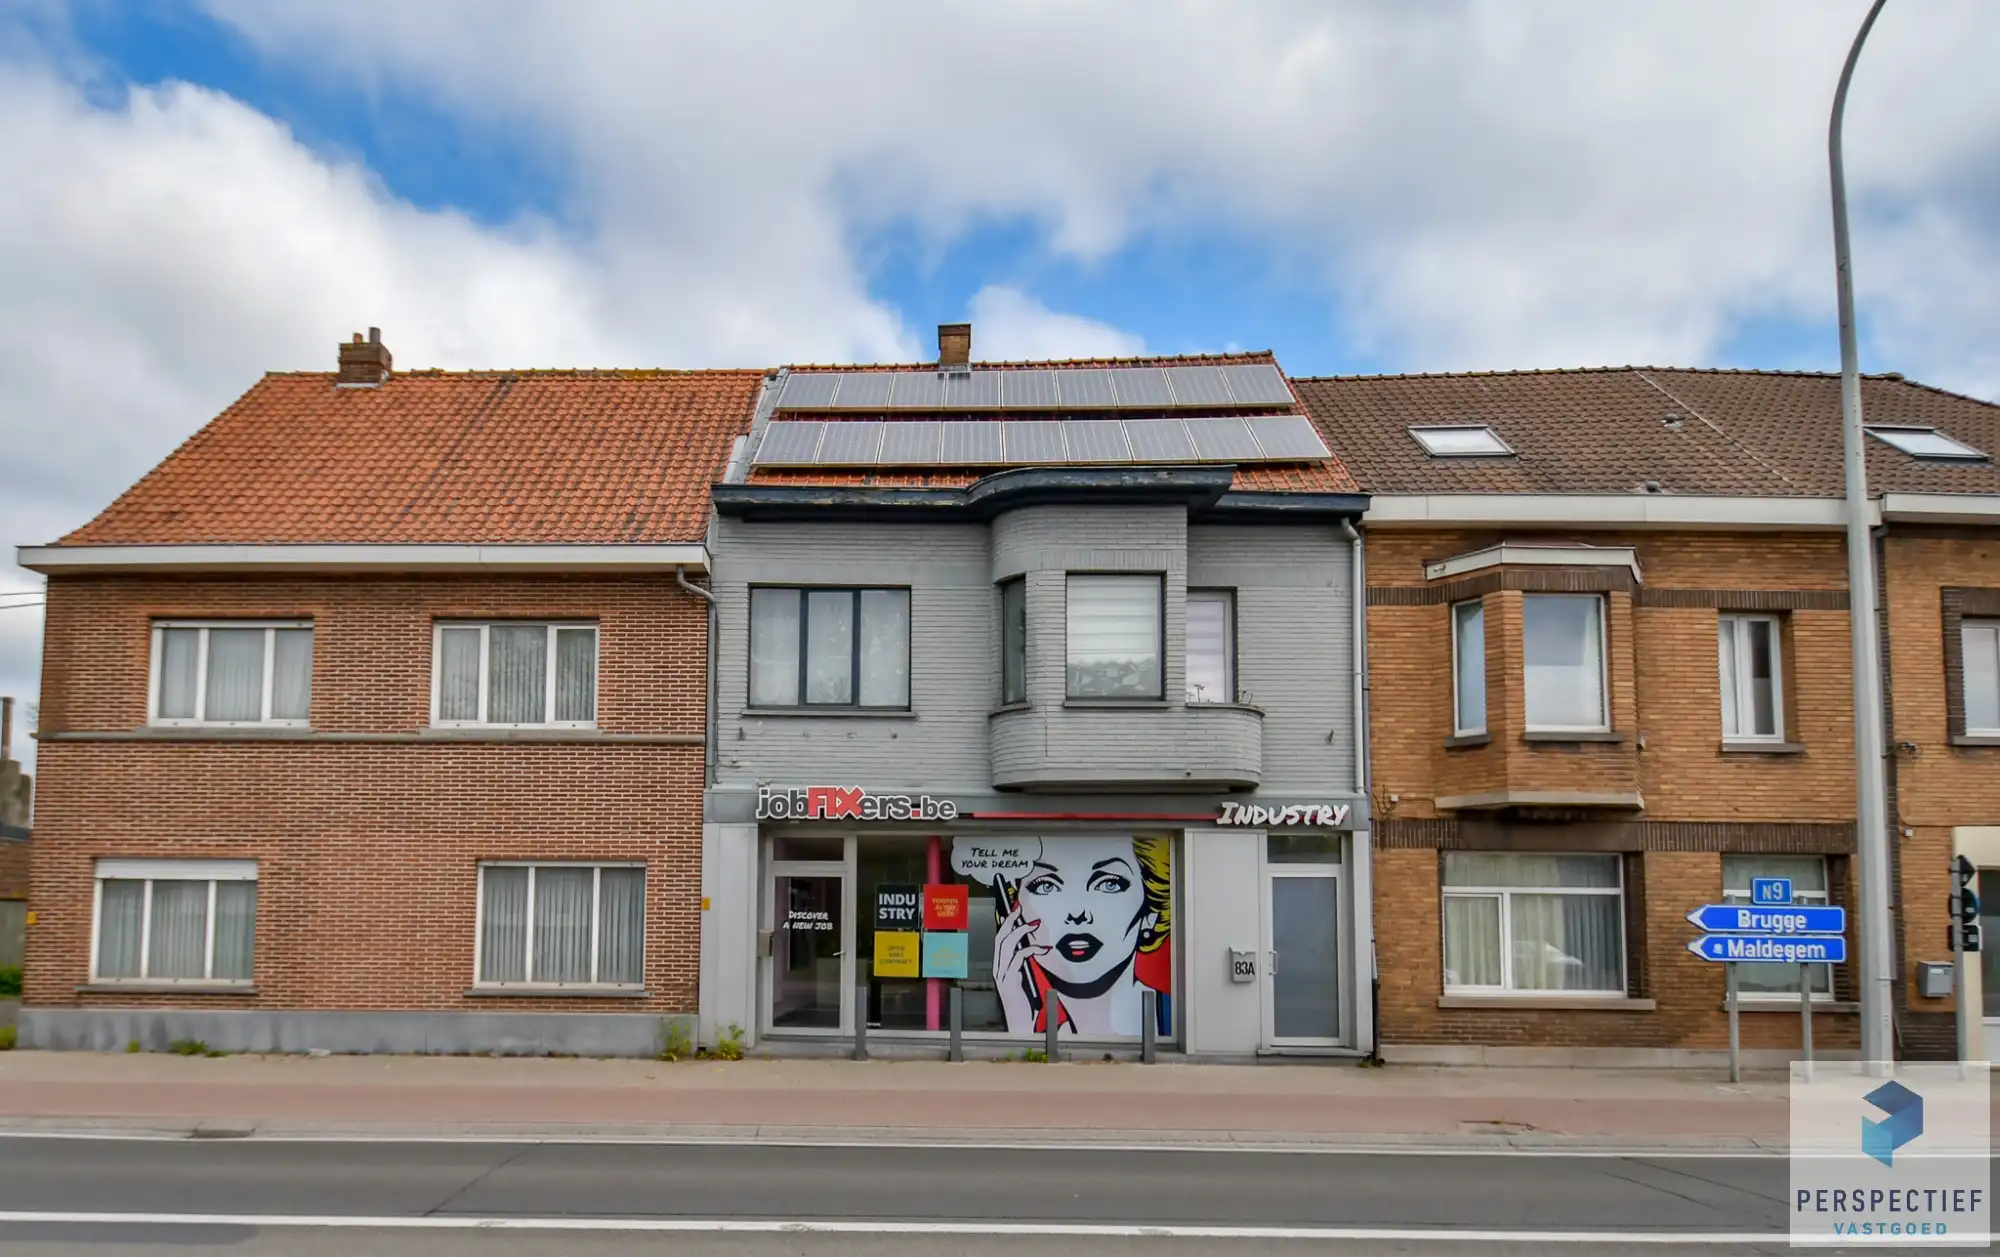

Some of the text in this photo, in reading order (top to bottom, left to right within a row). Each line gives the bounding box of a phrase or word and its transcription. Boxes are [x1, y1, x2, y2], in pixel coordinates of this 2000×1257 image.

[756, 786, 956, 820] jobFIXers.be
[1216, 802, 1349, 826] INDUSTRY
[971, 847, 1020, 857] TELL ME
[961, 860, 1028, 868] YOUR DREAM
[1762, 882, 1784, 900] N9
[878, 893, 916, 905] INDU
[788, 910, 829, 920] DISCOVER
[878, 907, 915, 920] STRY
[782, 921, 834, 930] A NEW JOB
[1737, 909, 1807, 933] Brugge
[1727, 939, 1826, 963] Maldegem
[1235, 961, 1255, 976] 83A
